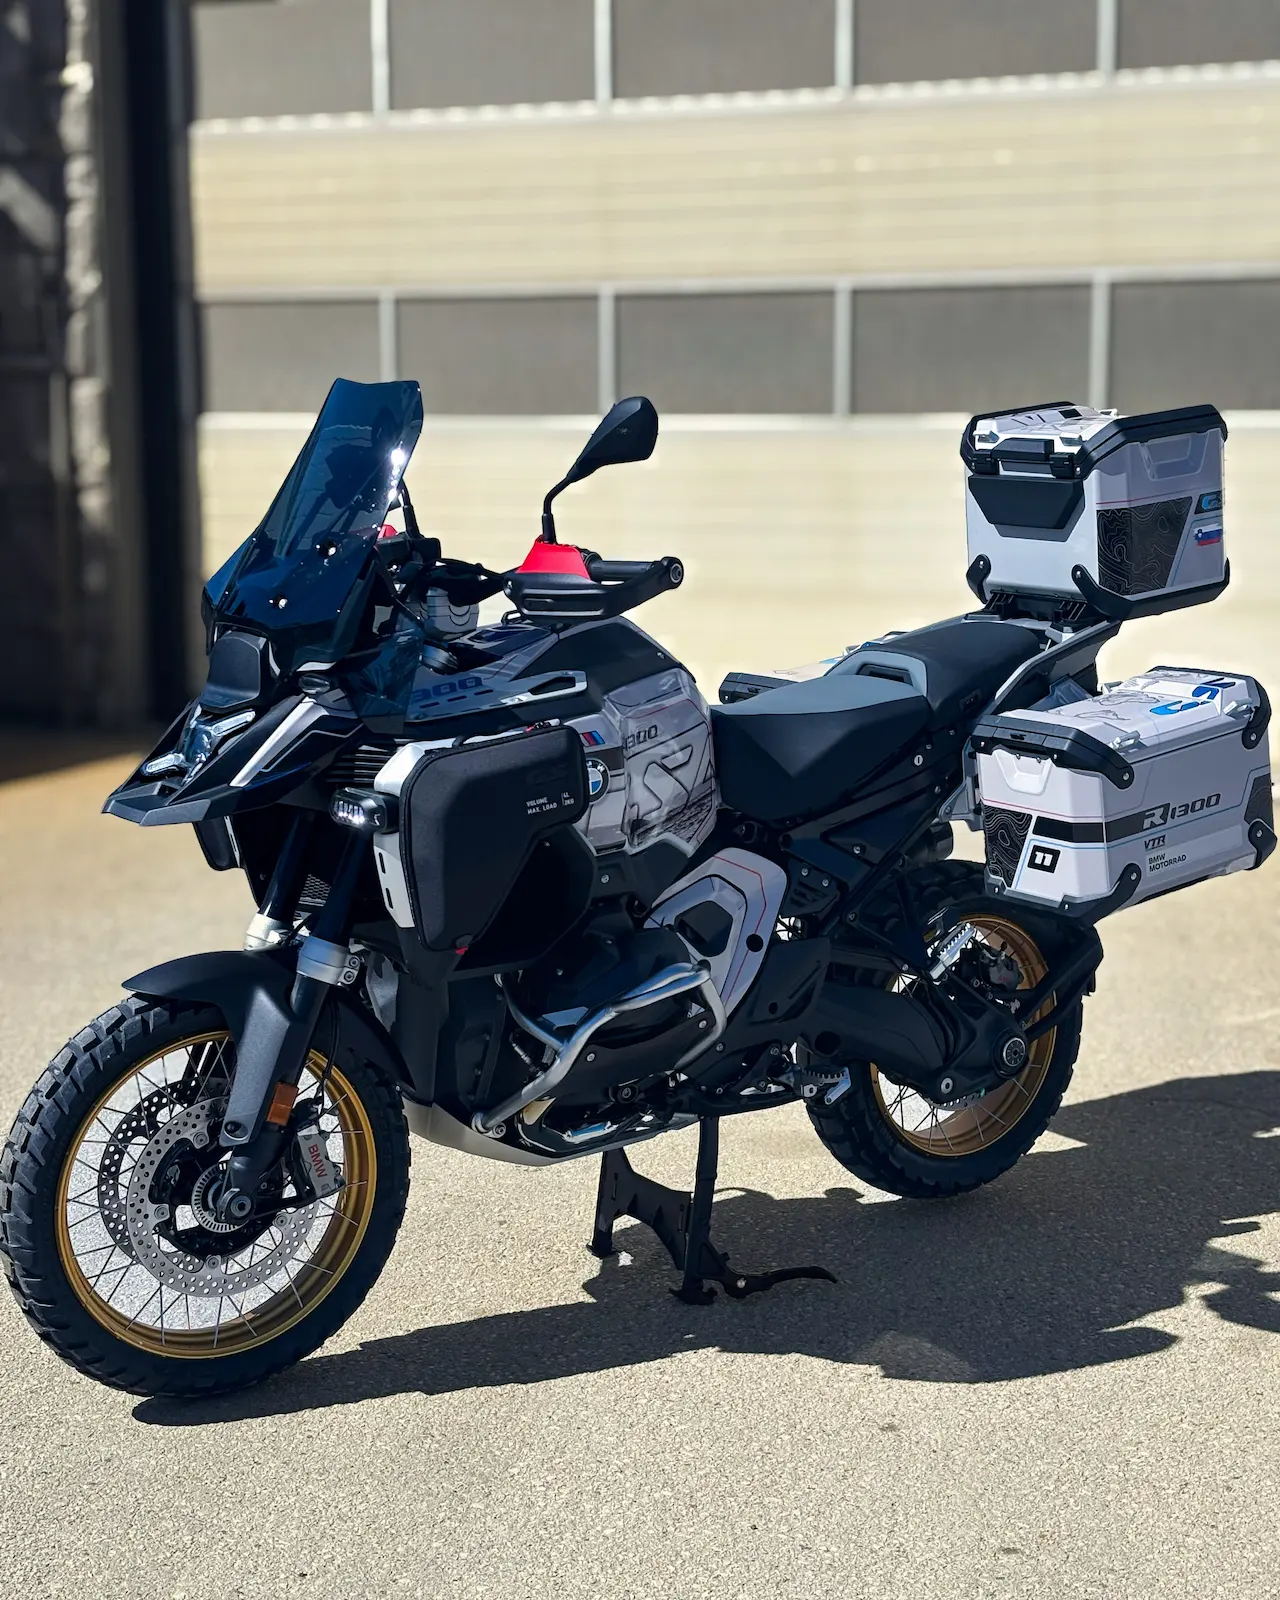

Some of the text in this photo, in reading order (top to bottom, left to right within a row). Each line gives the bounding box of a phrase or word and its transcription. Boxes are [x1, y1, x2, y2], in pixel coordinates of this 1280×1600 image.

[526, 796, 548, 807] VOLUME
[542, 802, 558, 811] LOAD
[1144, 834, 1166, 850] VTR
[1148, 854, 1166, 865] BMW
[1149, 854, 1187, 873] MOTORRAD
[308, 1143, 328, 1178] BMW
